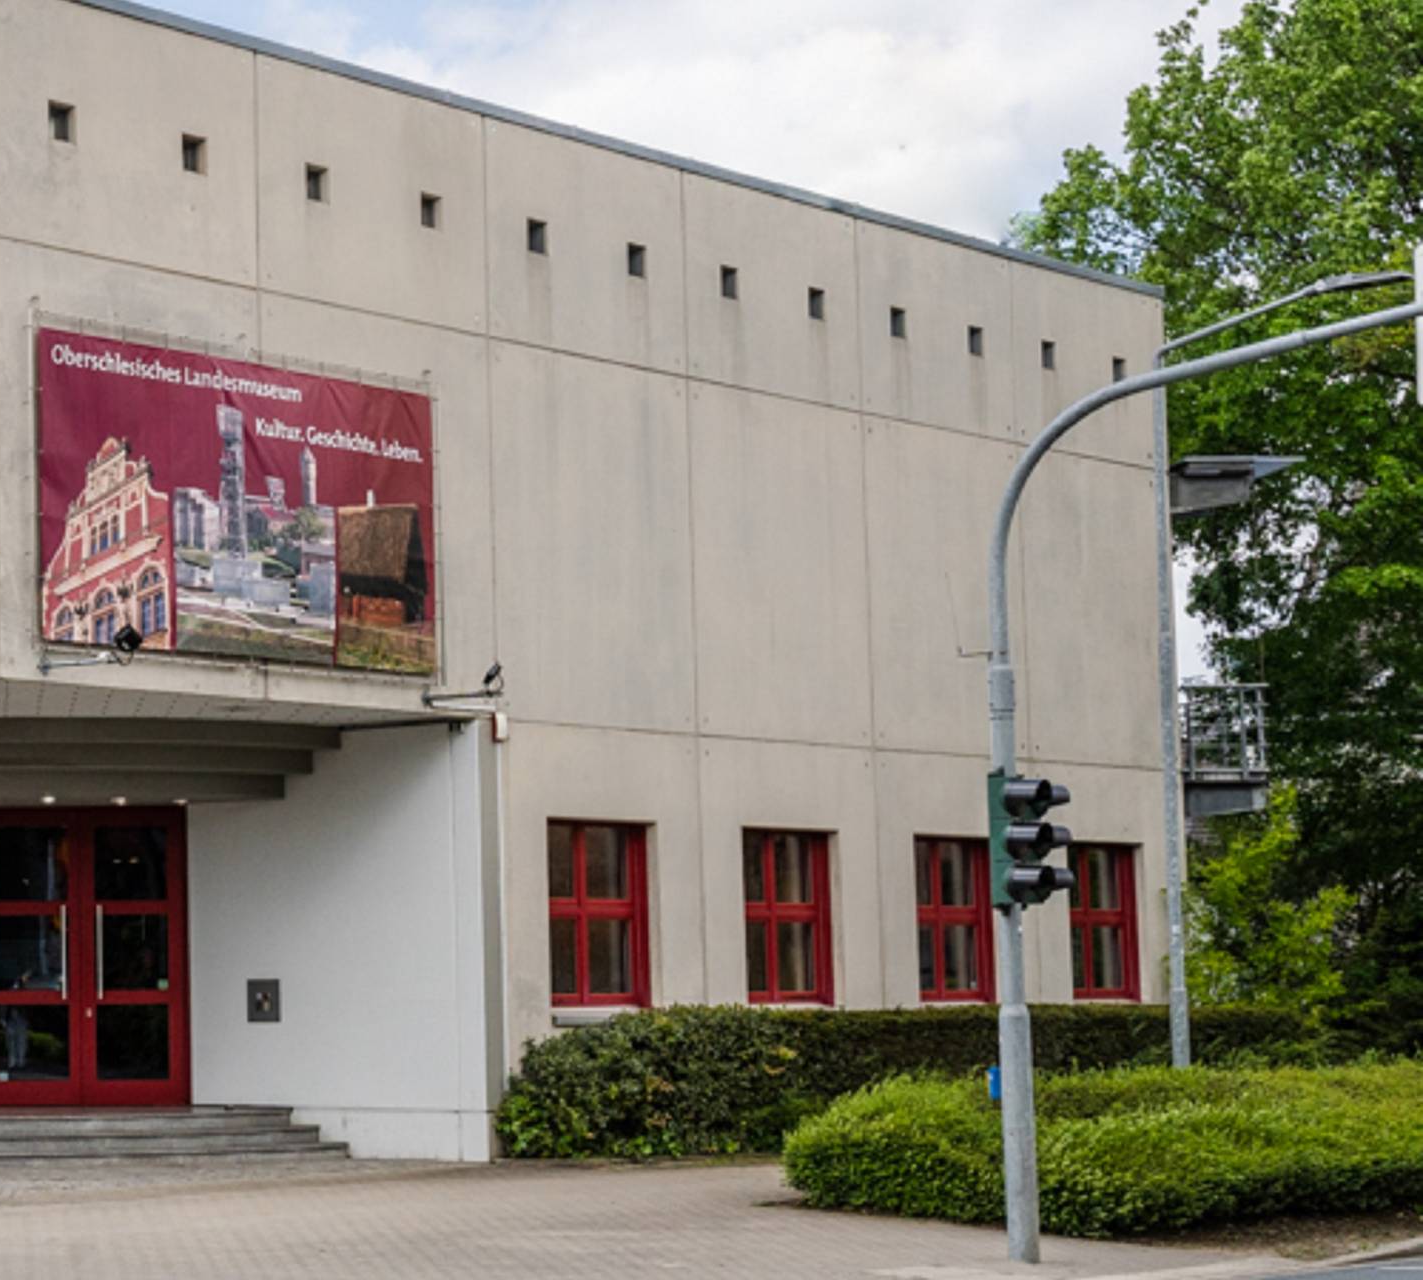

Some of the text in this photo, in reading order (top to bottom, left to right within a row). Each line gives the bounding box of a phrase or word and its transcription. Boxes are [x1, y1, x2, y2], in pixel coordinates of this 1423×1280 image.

[50, 343, 303, 403] Oberschlesisches Landesmuseum
[255, 417, 306, 443] Kultur.
[380, 437, 424, 463] Leben.
